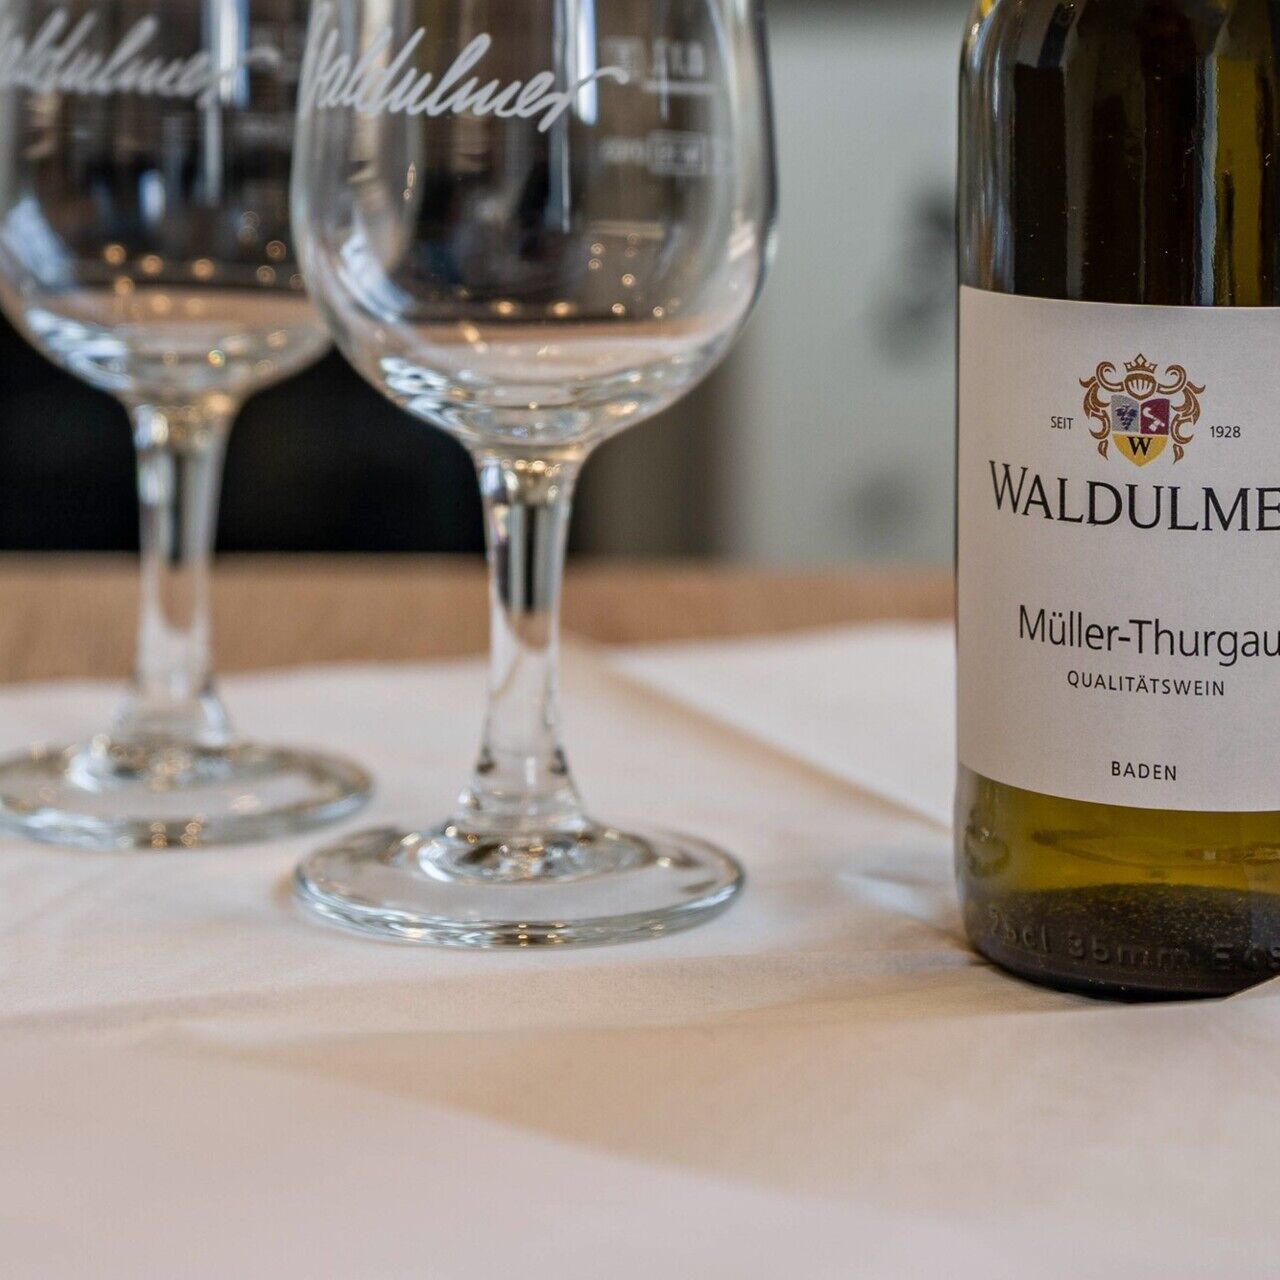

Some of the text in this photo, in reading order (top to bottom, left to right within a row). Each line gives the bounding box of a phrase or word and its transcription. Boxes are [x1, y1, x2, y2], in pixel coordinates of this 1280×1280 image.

[1050, 415, 1242, 439] SEIT 1928
[1127, 435, 1153, 456] W
[1066, 669, 1226, 697] QUALITÄTSWEIN
[1110, 760, 1178, 782] BADEN
